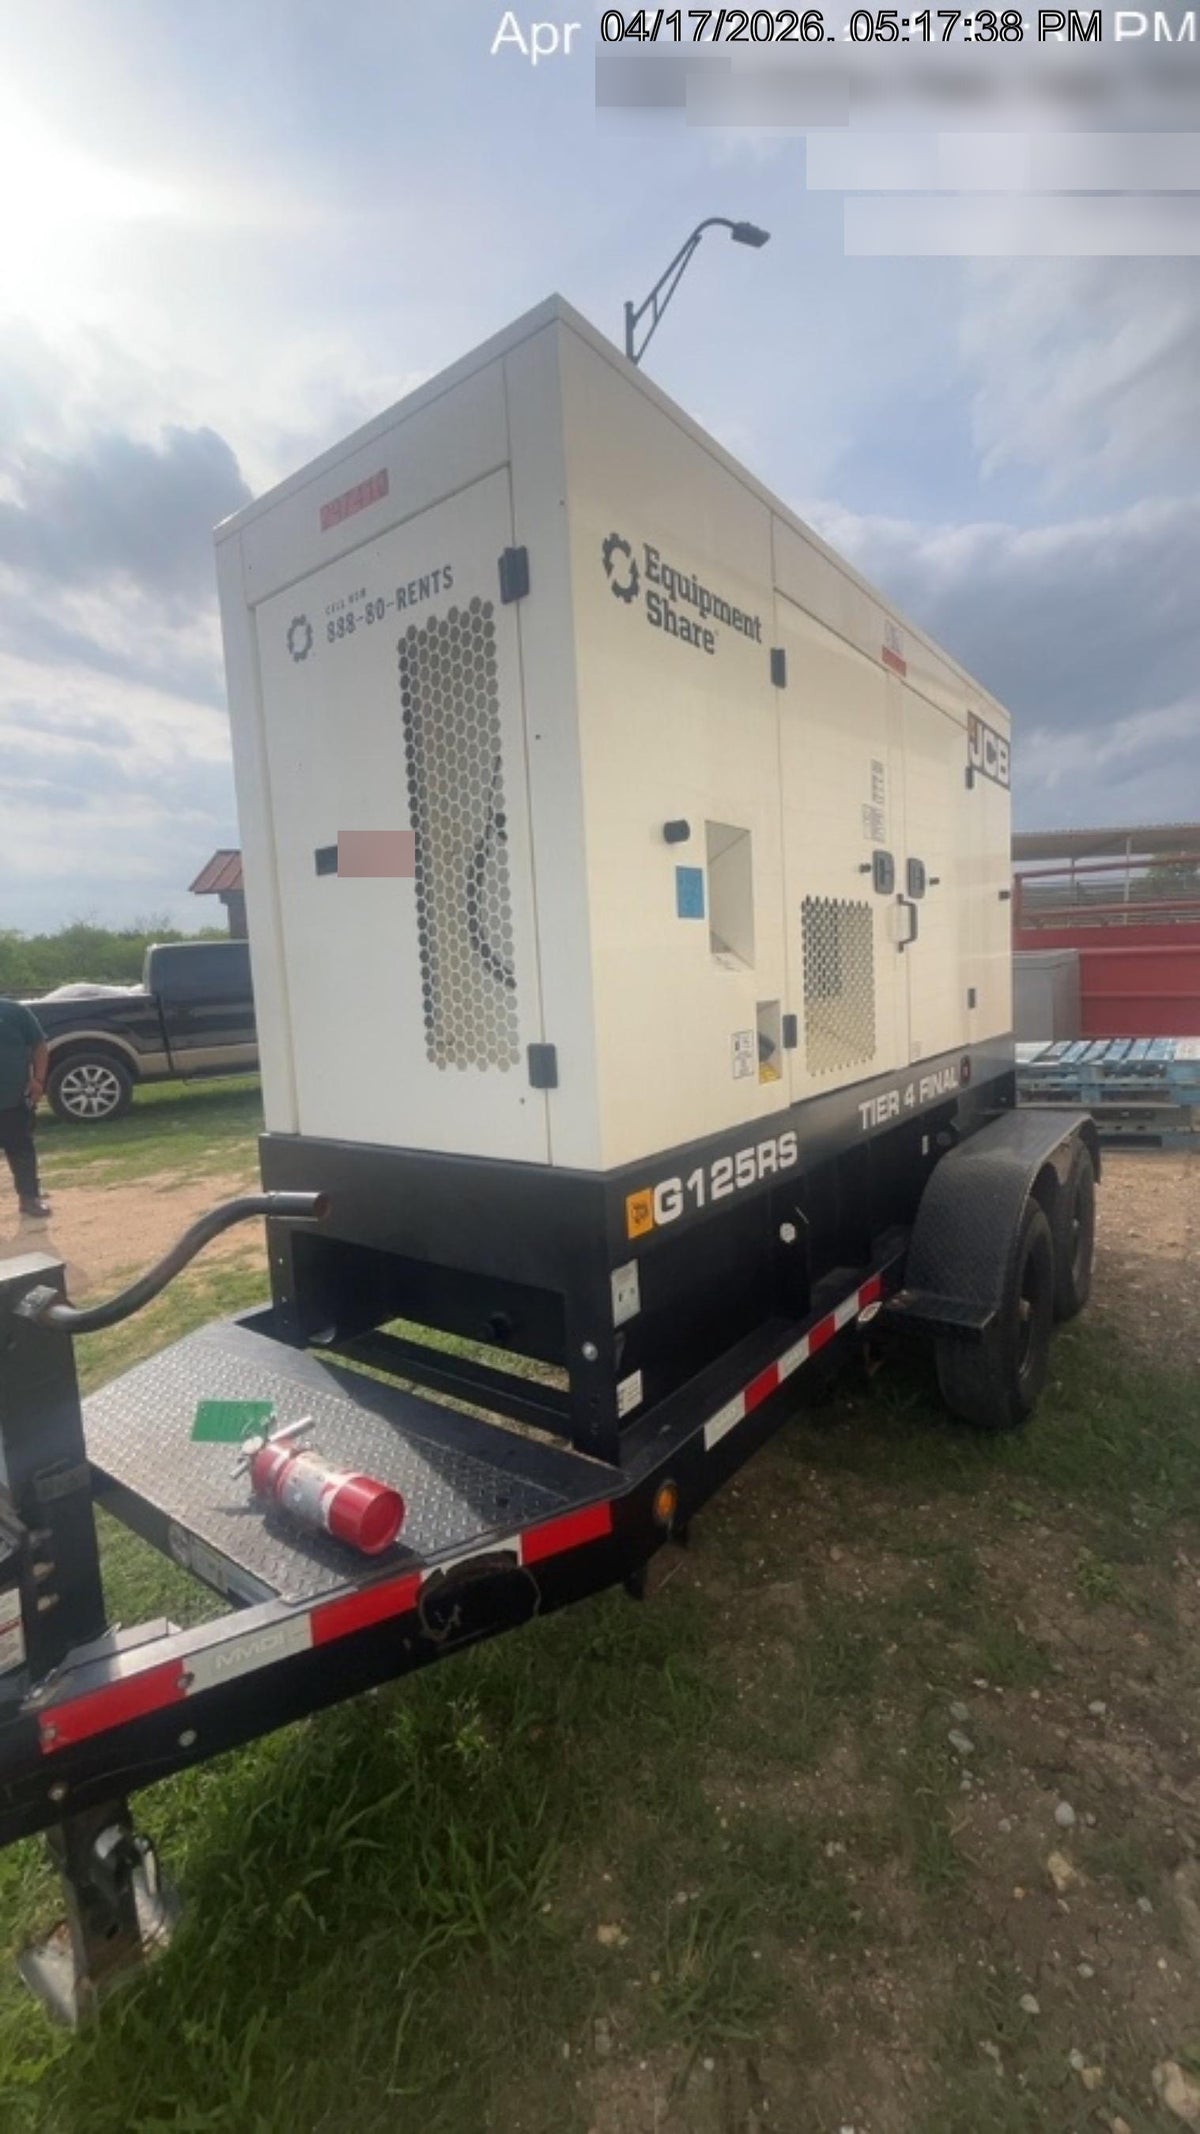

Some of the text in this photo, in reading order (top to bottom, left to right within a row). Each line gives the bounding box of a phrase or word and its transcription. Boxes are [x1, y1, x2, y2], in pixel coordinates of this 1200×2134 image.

[326, 564, 454, 643] 888-80-RENTS
[643, 542, 762, 645] Equipment
[646, 589, 715, 656] Share
[968, 713, 1010, 788] JCB
[858, 1066, 960, 1130] TIER 4 FINAL
[653, 1130, 799, 1226] G125RS
